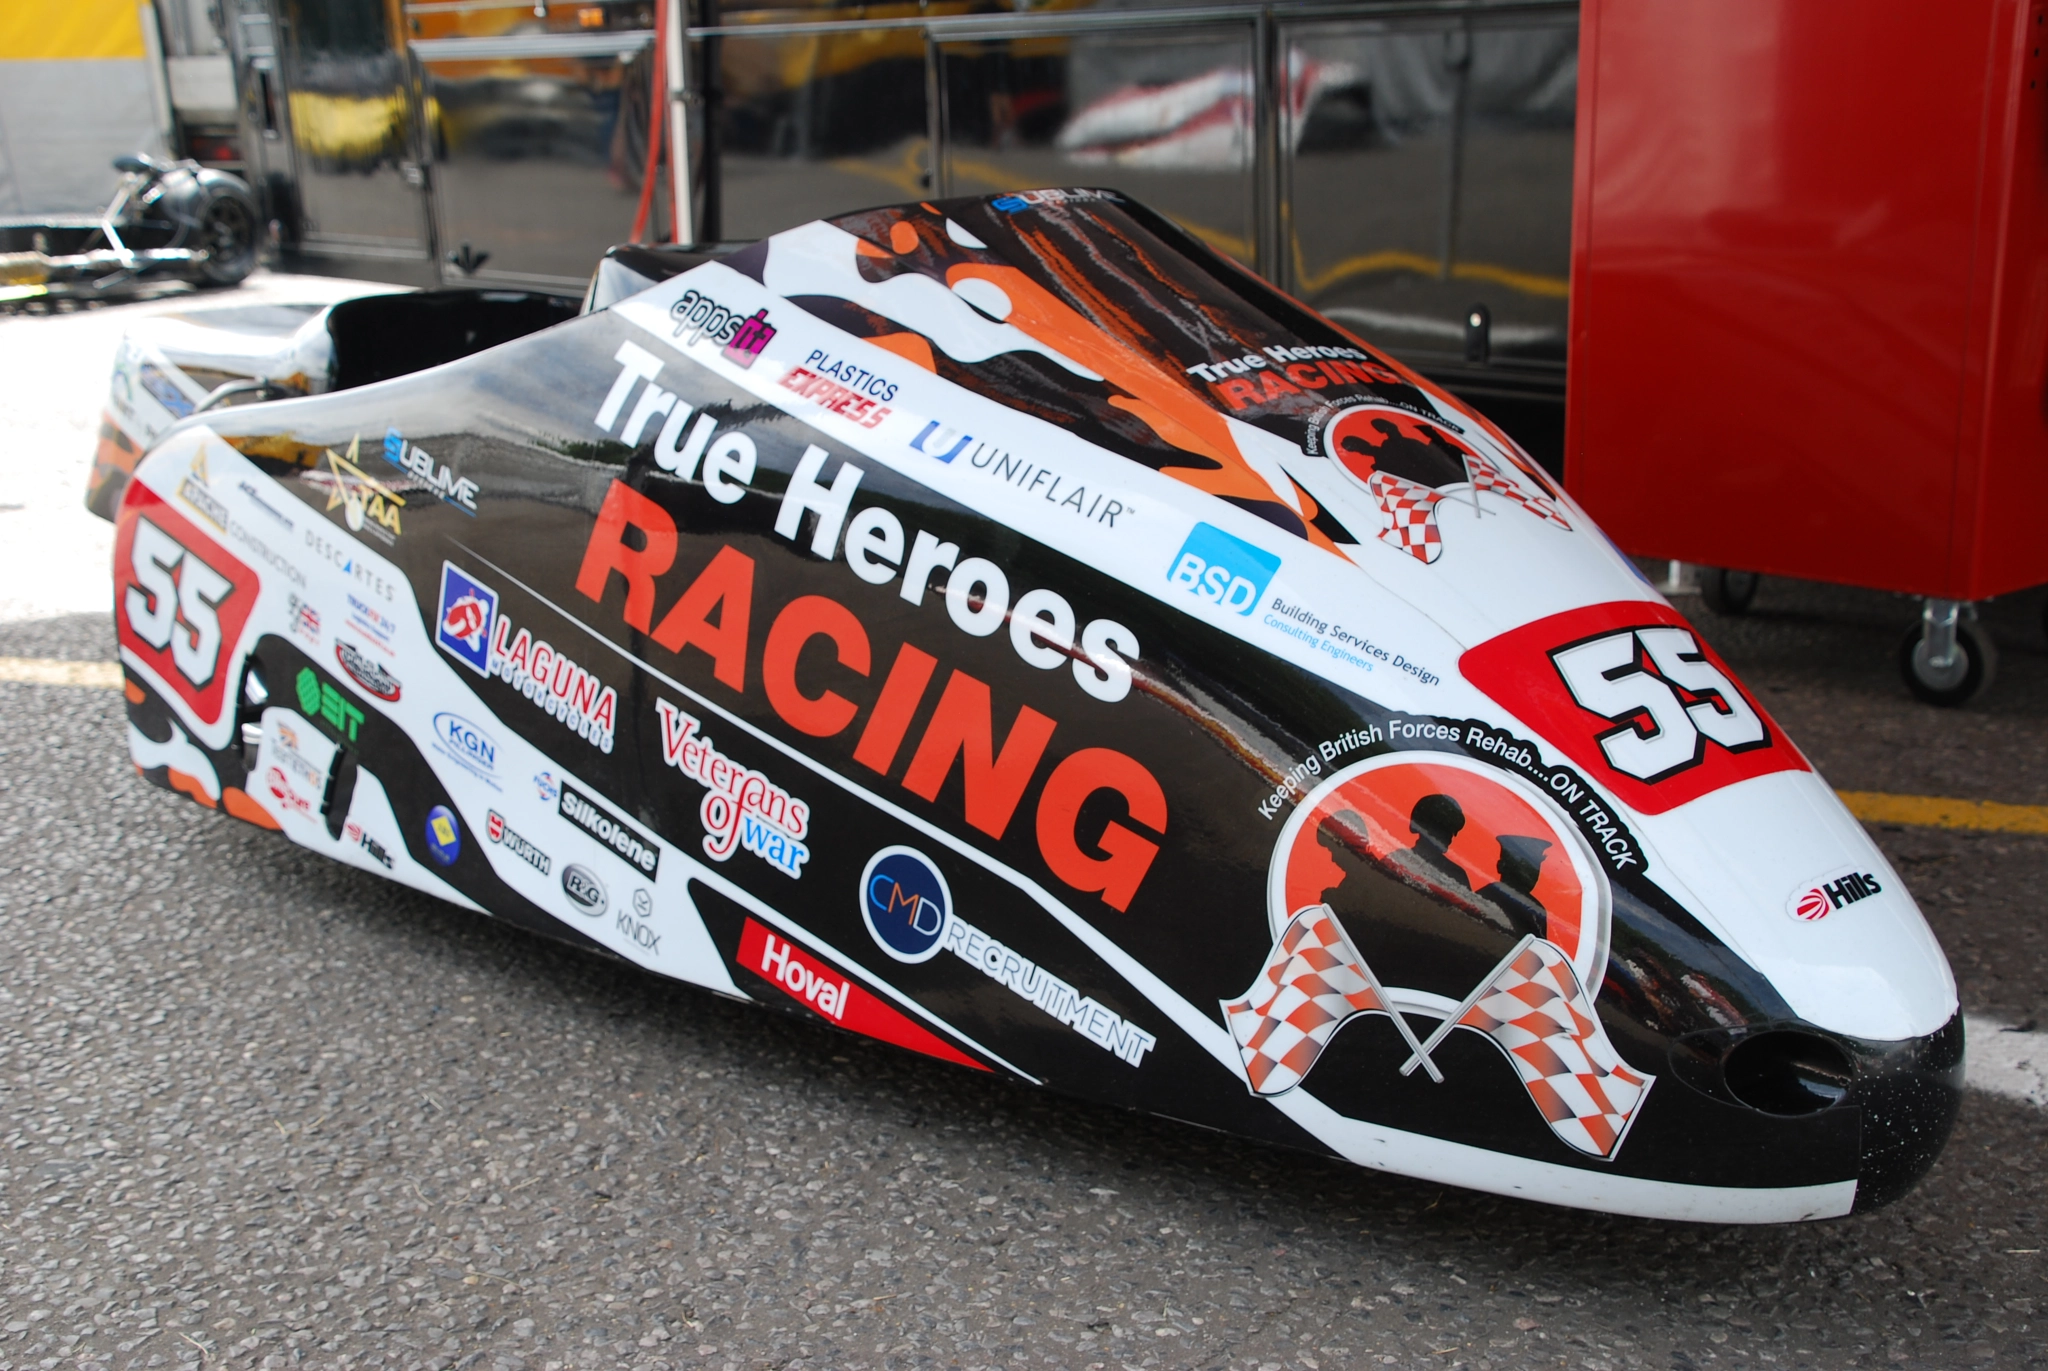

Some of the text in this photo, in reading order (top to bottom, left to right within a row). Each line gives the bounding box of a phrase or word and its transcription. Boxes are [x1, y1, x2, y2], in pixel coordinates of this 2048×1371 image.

[776, 366, 892, 429] EXPRESS
[805, 349, 898, 402] PLASTICS
[1186, 345, 1368, 383] True Heroes
[1216, 360, 1403, 411] RACING
[383, 428, 479, 511] SUBLIME
[1305, 425, 1319, 455] Keeping
[594, 339, 1141, 703] True Heroes
[971, 442, 1123, 528] UNIFLAIR
[124, 513, 234, 690] 55
[305, 529, 395, 602] DESCARTES
[1170, 552, 1440, 687] BSD Building Services Design
[1264, 613, 1374, 672] Consulting Engineers
[491, 656, 613, 752] MOTORCYCLES
[494, 617, 615, 733] LAGUNA
[574, 478, 1168, 914] RACING
[1549, 626, 1769, 782] 55
[450, 720, 494, 763] KGN
[660, 702, 808, 836] Veterans
[561, 791, 656, 872] Silkolene
[704, 777, 753, 857] of
[1257, 754, 1322, 821] Keeping
[1318, 724, 1383, 763] British
[1389, 720, 1461, 742] Forces
[1579, 799, 1637, 870] TRACK
[361, 832, 392, 869] Hills
[744, 816, 805, 872] war
[568, 873, 600, 906] R&G
[1822, 871, 1882, 909] Hills
[615, 908, 662, 956] KNOX
[868, 873, 1154, 1063] CMD RECRUITMENT
[760, 933, 850, 1020] Hoval
